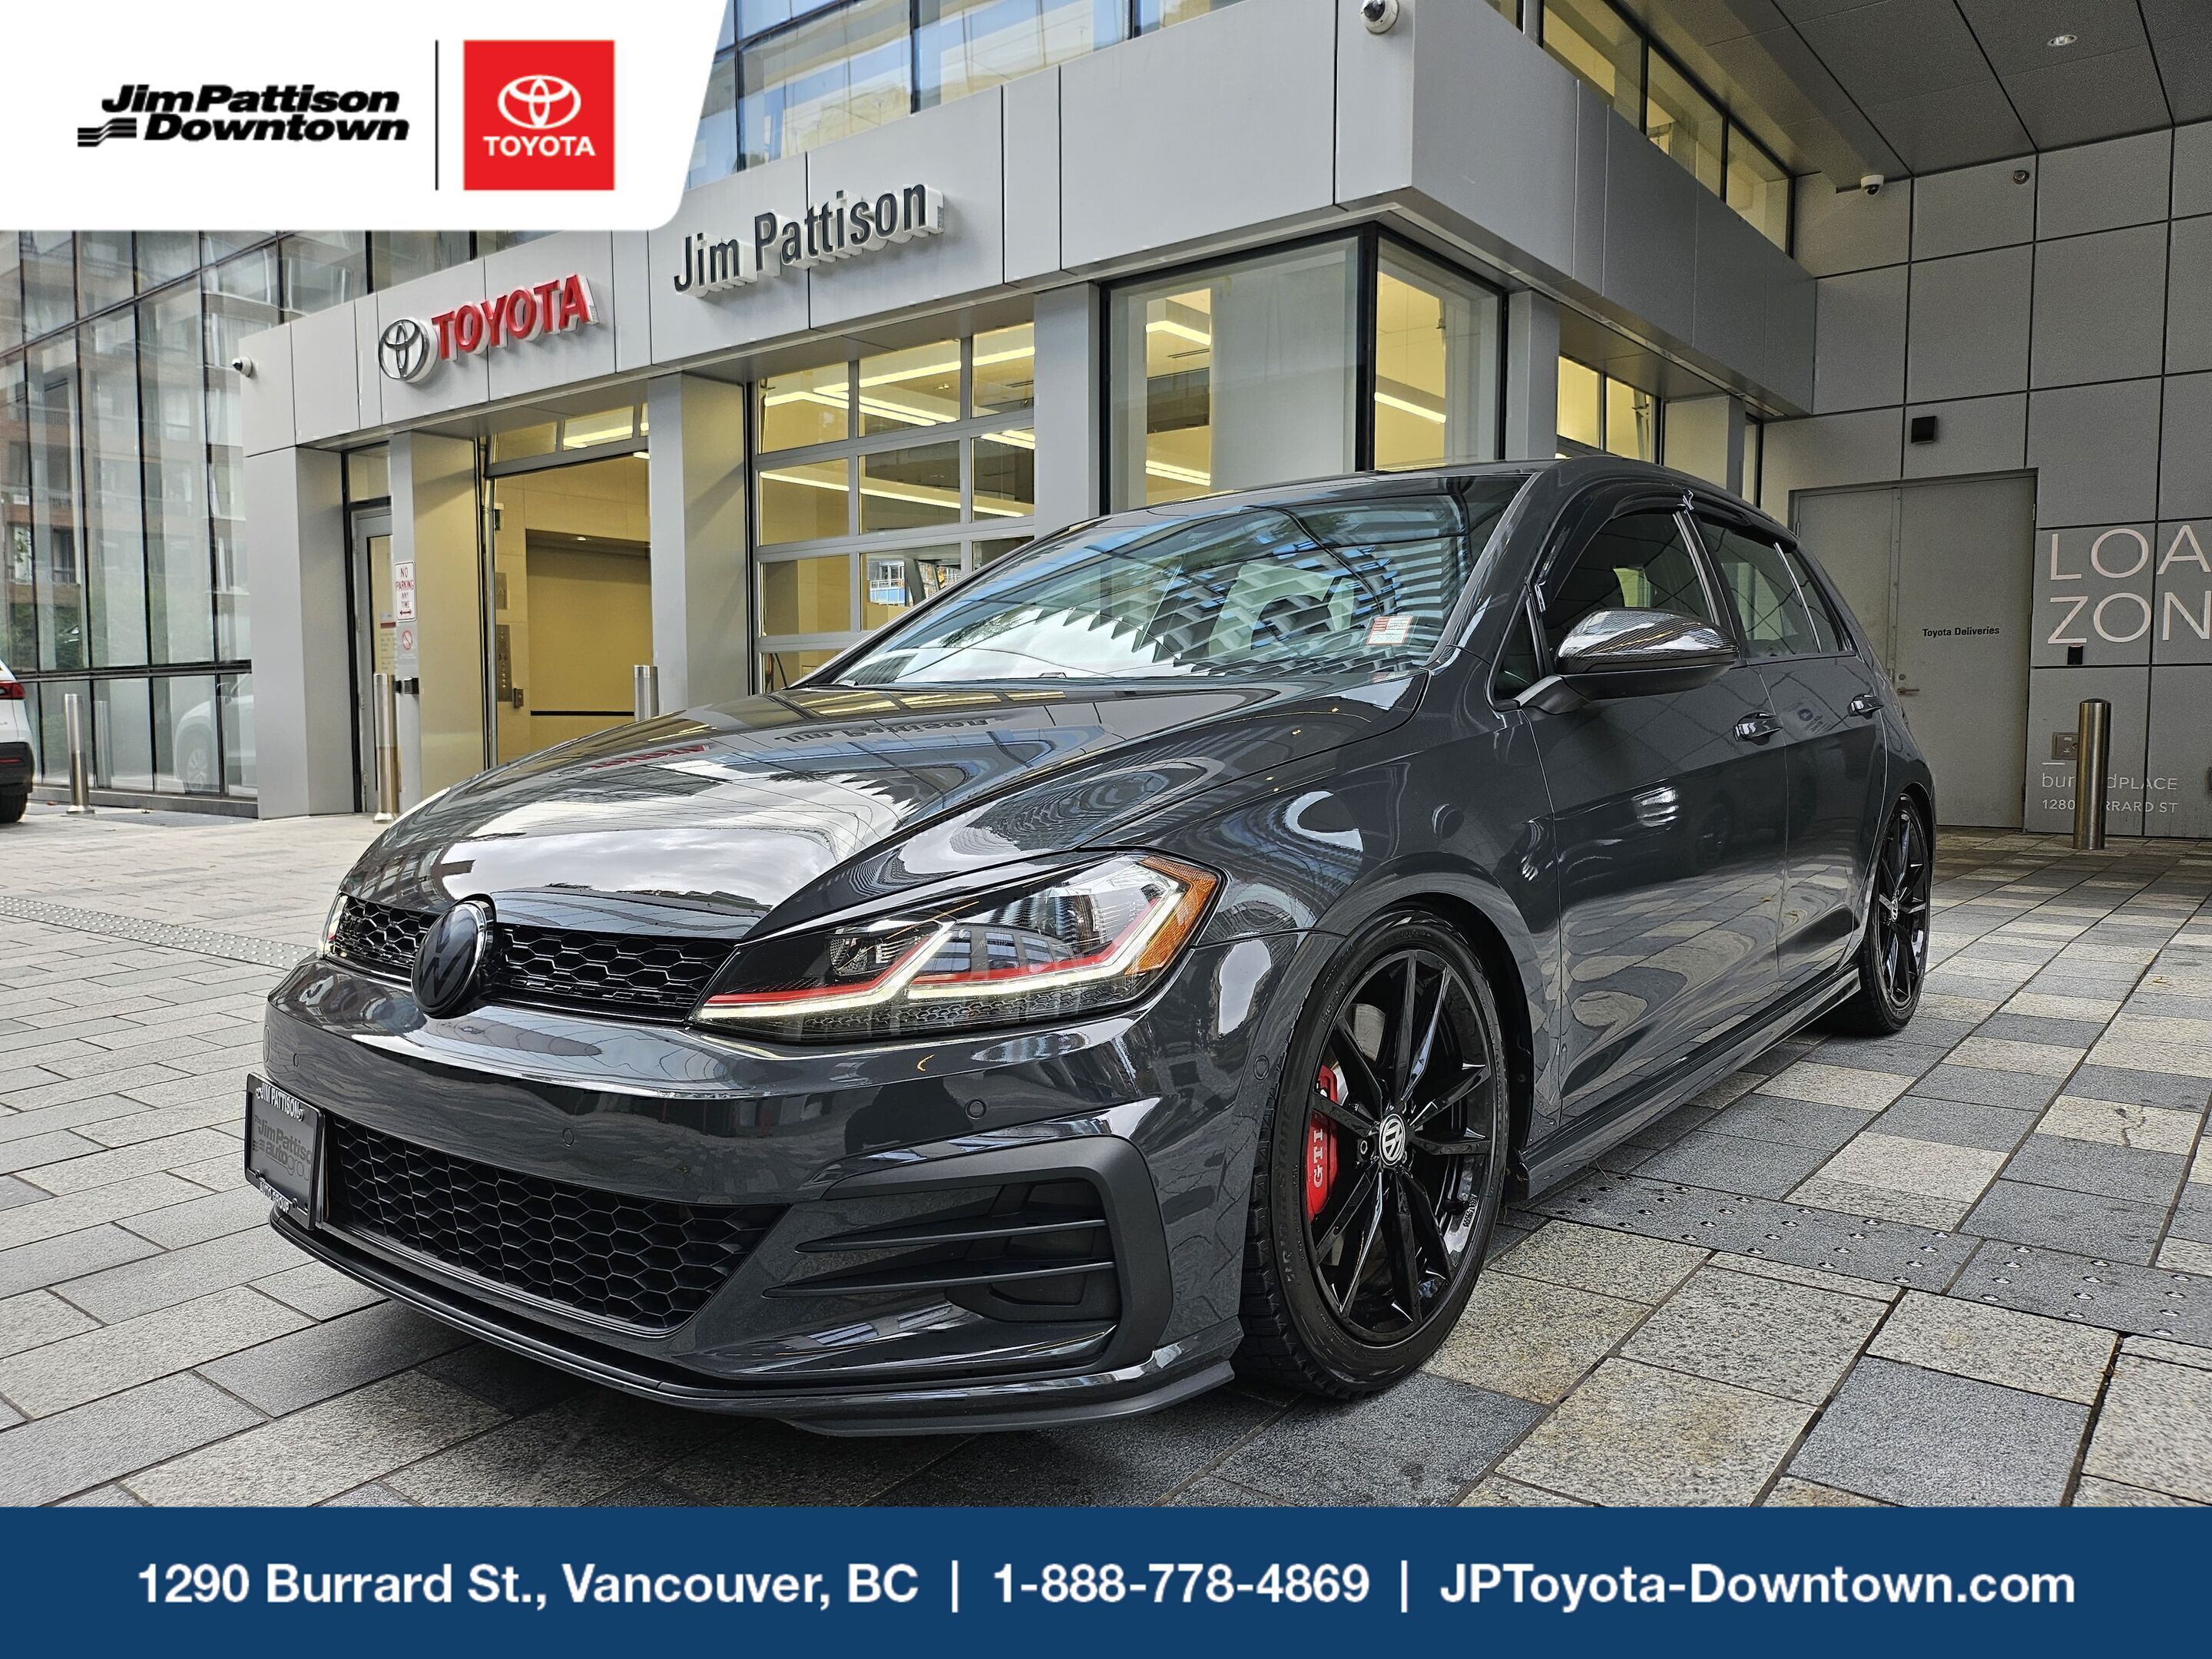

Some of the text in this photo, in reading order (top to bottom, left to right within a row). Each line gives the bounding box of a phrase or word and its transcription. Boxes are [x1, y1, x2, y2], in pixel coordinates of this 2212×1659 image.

[674, 184, 926, 293] Jim Pattison
[432, 274, 591, 360] TOYOTA
[400, 567, 409, 578] NO
[2050, 525, 2211, 581] LOA
[396, 579, 415, 591] PARKING
[1922, 626, 2000, 638] Toyota Deliveries
[2048, 591, 2212, 644] ZON
[2042, 799, 2075, 810] 1280
[2159, 802, 2179, 813] ST
[1313, 1128, 1323, 1187] GTI
